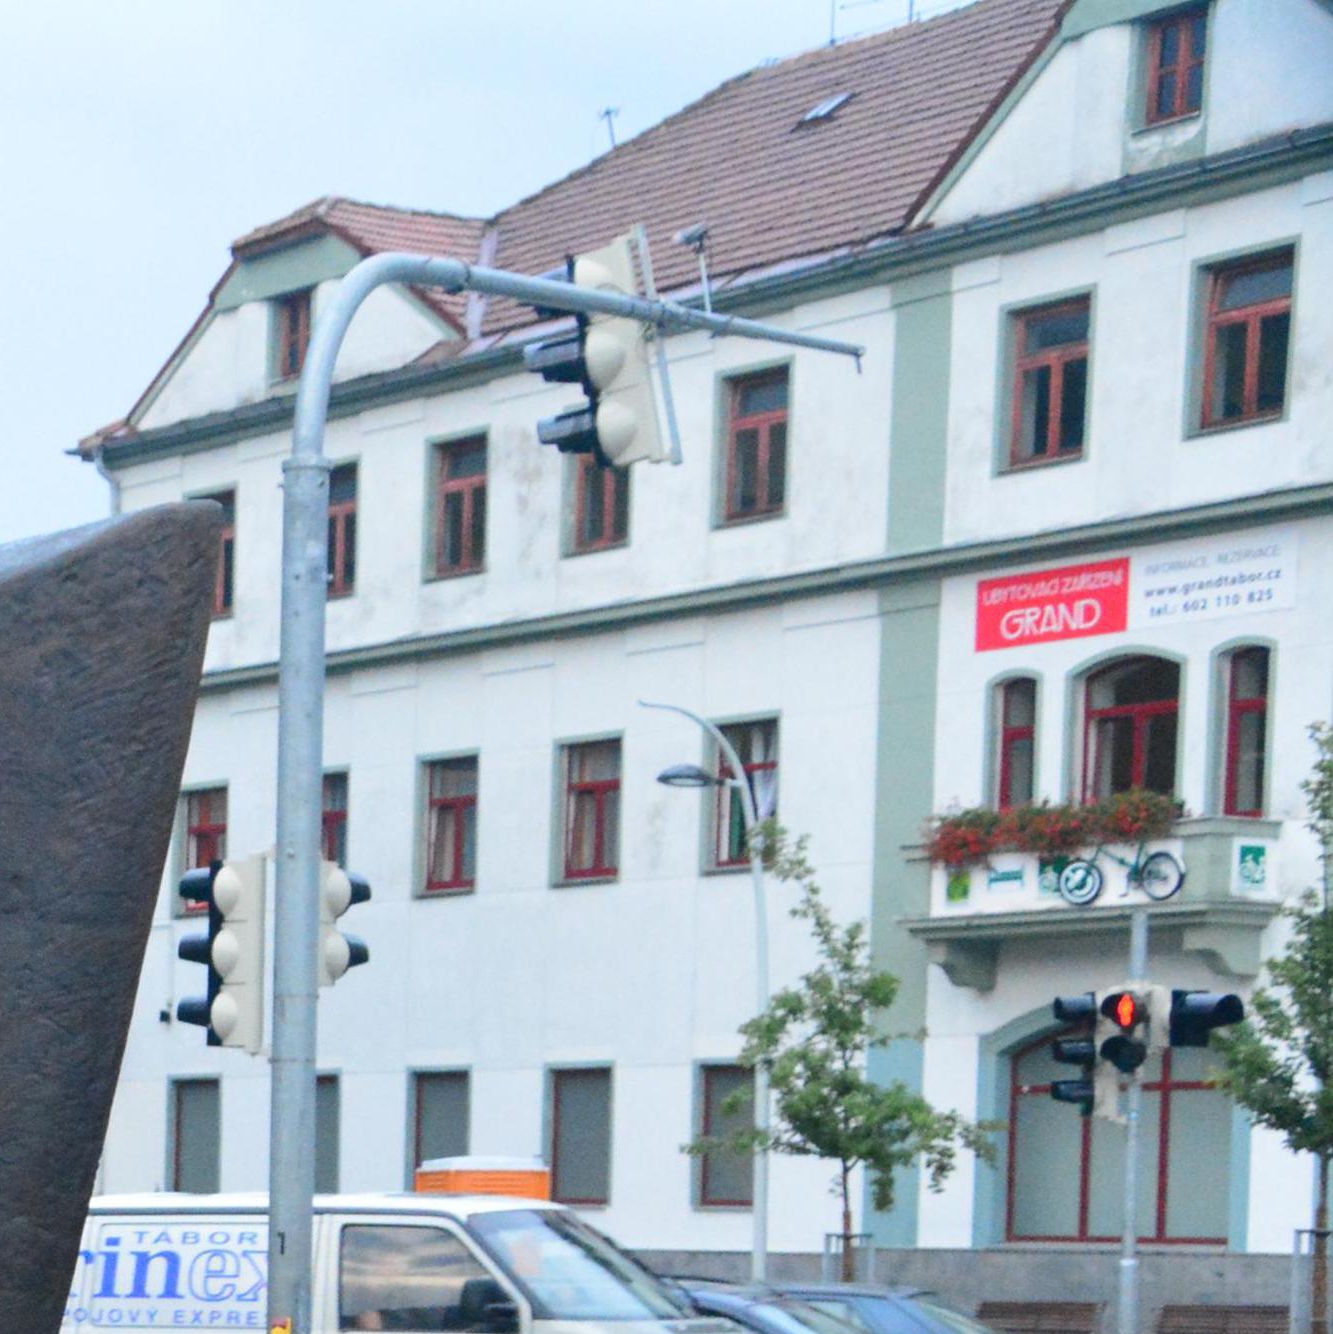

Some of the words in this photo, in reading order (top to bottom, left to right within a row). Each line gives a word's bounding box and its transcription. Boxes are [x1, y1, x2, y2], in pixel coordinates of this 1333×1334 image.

[1145, 568, 1282, 598] www.grandtabor.cz
[1216, 594, 1241, 607] 110
[1000, 598, 1102, 640] GRAND
[173, 1309, 267, 1326] EXPRE
